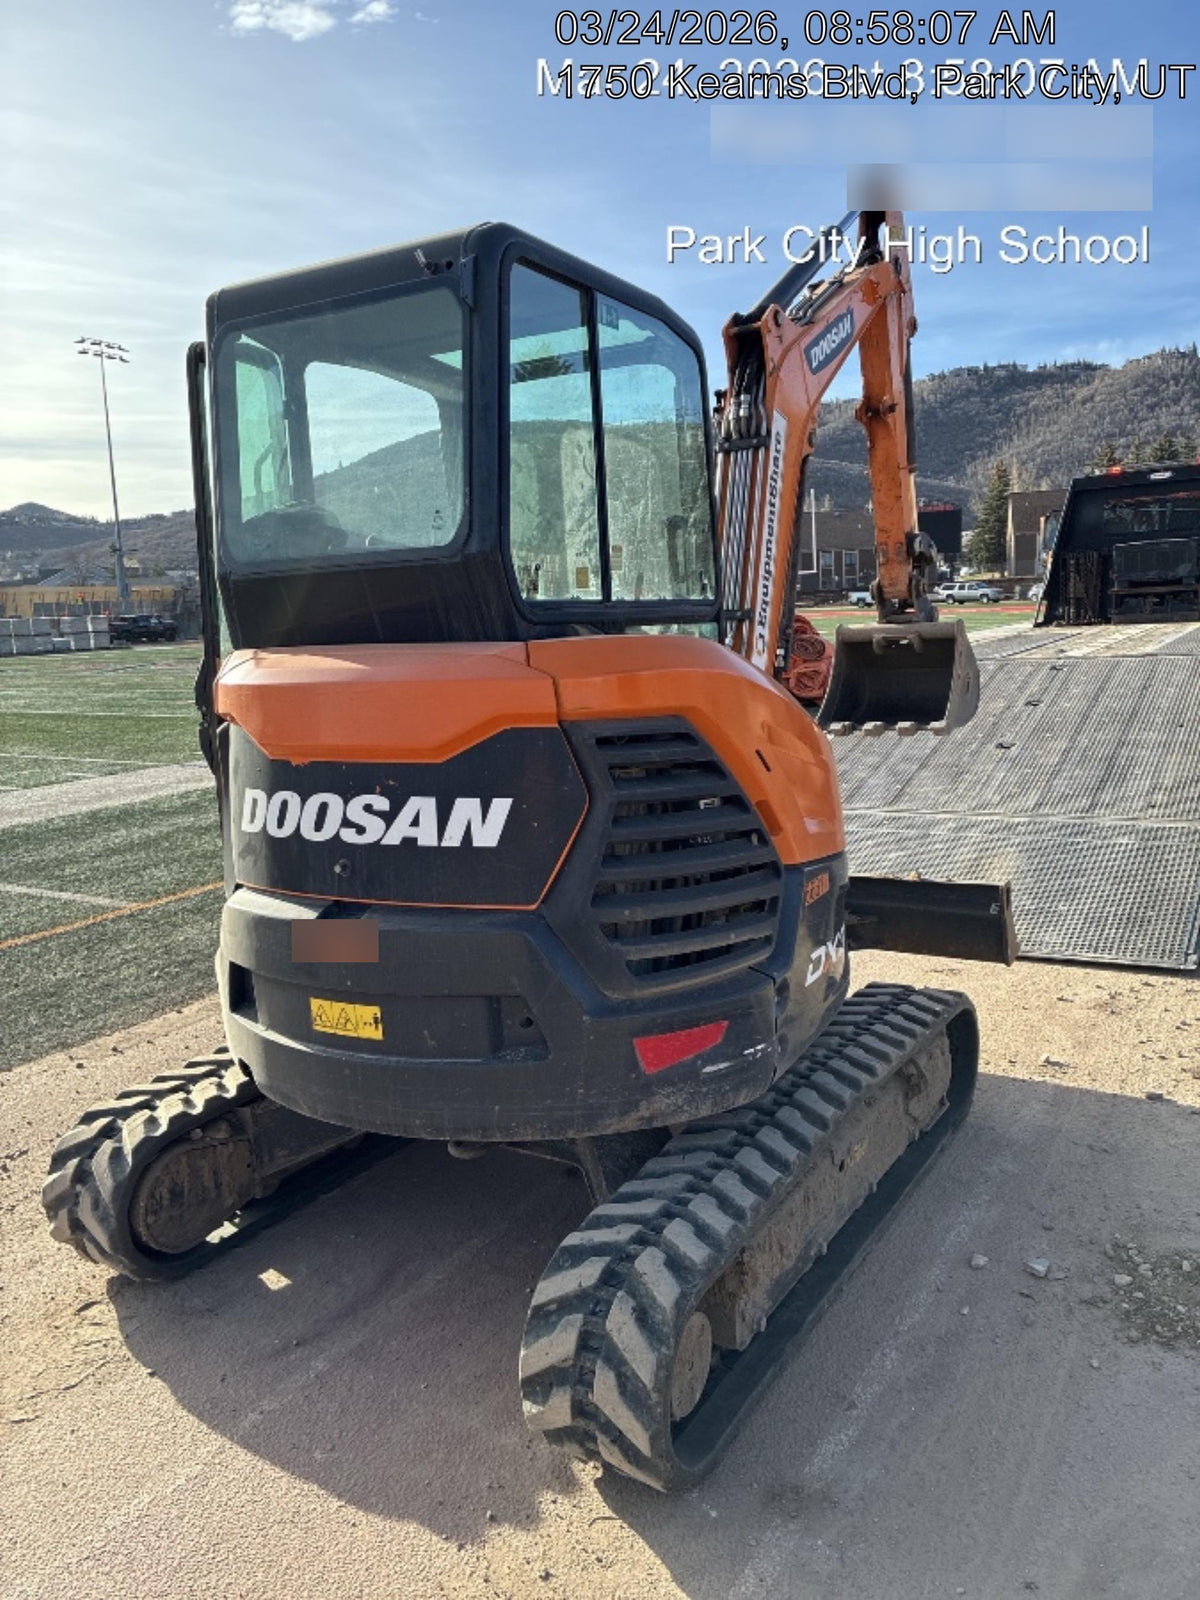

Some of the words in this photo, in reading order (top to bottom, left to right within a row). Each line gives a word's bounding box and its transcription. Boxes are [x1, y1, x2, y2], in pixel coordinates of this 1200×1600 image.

[810, 313, 852, 369] DOOSAN
[757, 431, 782, 629] EquipmentShare
[241, 788, 514, 847] DOOSAN
